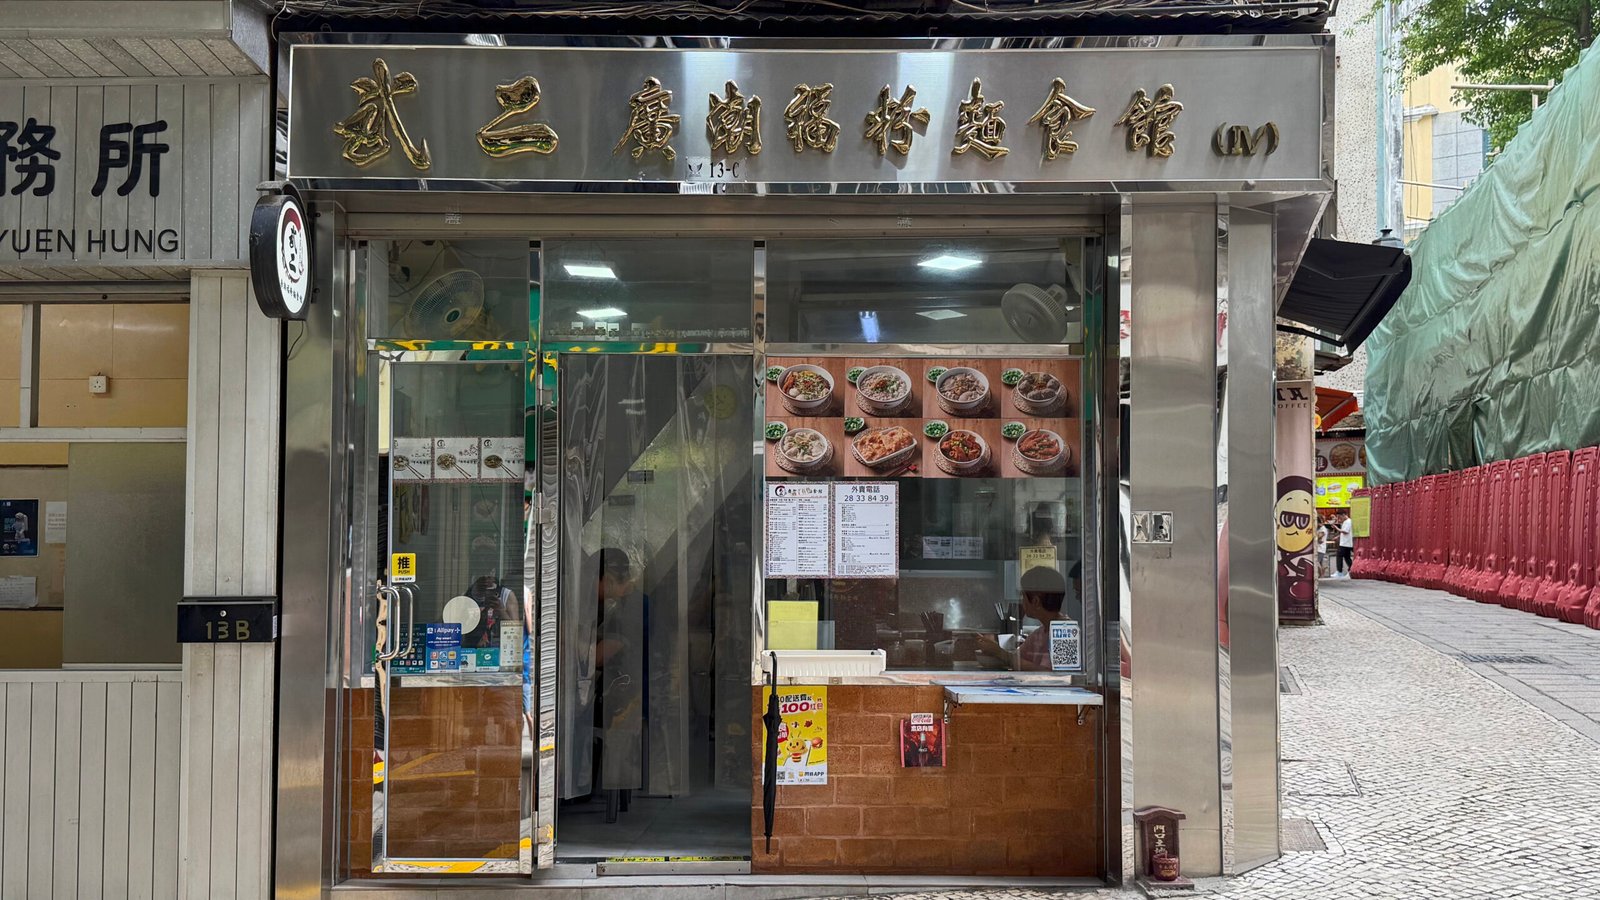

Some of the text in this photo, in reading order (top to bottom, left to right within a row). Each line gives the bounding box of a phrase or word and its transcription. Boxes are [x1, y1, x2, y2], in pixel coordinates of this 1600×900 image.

[0, 117, 170, 197] 務所
[710, 161, 740, 178] 13-C
[87, 228, 179, 253] HUNG
[852, 485, 880, 493] 外賣電話
[844, 494, 889, 502] 28 33 84 39
[397, 556, 410, 570] 推
